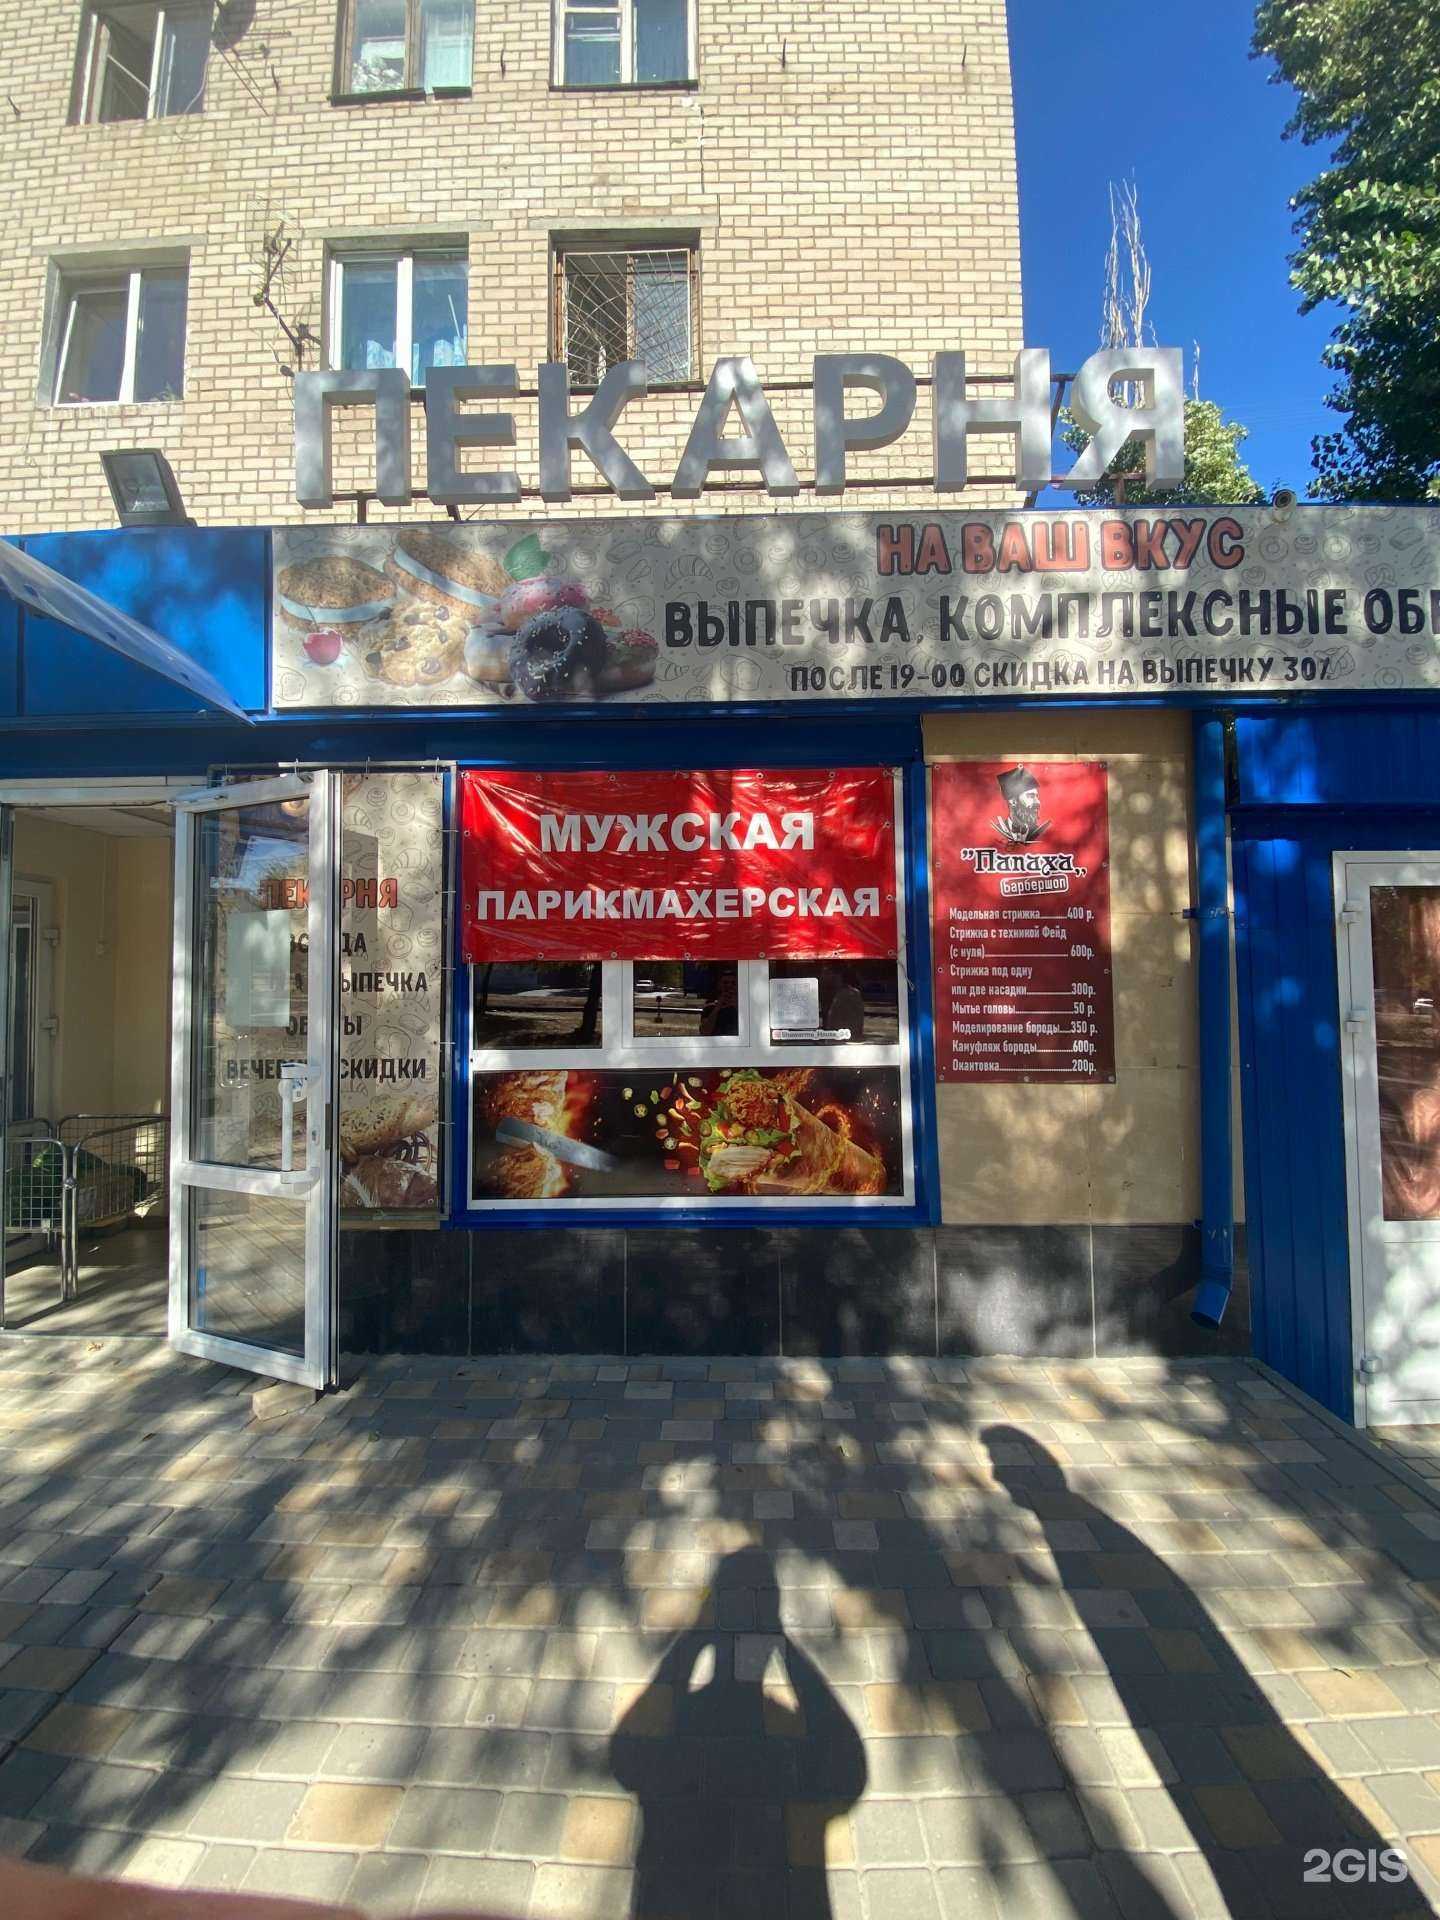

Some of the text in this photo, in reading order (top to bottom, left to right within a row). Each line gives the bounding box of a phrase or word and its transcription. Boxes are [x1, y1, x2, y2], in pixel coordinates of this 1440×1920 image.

[294, 347, 1185, 509] ПЕКАРНЯ
[877, 516, 1245, 576] НА ВАШ ВКУС
[665, 595, 924, 647] ВЫПЕЧКА,
[939, 589, 1348, 642] КОМПЛЕКСНЫЕ
[791, 664, 883, 691] ПОСЛЕ
[890, 660, 966, 689] 19-00
[975, 661, 1090, 691] СКИДКА
[1098, 659, 1134, 685] НА
[1142, 656, 1273, 684] ВЫПЕЧКУ
[539, 812, 815, 852] МУЖСКАЯ
[259, 878, 398, 910] ПЕКРНЯ
[477, 887, 881, 921] ПАРИКМАХЕРСКАЯ
[950, 907, 1000, 920] Модельная
[1002, 909, 1041, 922] стрижка
[1067, 907, 1085, 919] 400
[950, 926, 988, 940] Стрижка
[999, 926, 1040, 938] техникой
[1042, 926, 1067, 940] Фейд
[341, 972, 428, 993] ЫПЕЧКА
[950, 965, 1032, 979] Стрижка под одну
[951, 986, 966, 995] или
[969, 986, 986, 997] две
[988, 986, 1027, 997] насадки
[952, 1002, 981, 1014] Мытье
[983, 1004, 1016, 1014] головы
[1073, 1002, 1084, 1014] 50
[952, 1021, 1023, 1035] Моделирование
[1026, 1021, 1061, 1036] бороды
[1070, 1021, 1087, 1033] 350
[1003, 1040, 1037, 1055] бороды
[341, 1058, 426, 1083] СКИДКИ
[952, 1059, 999, 1072] Окантовка
